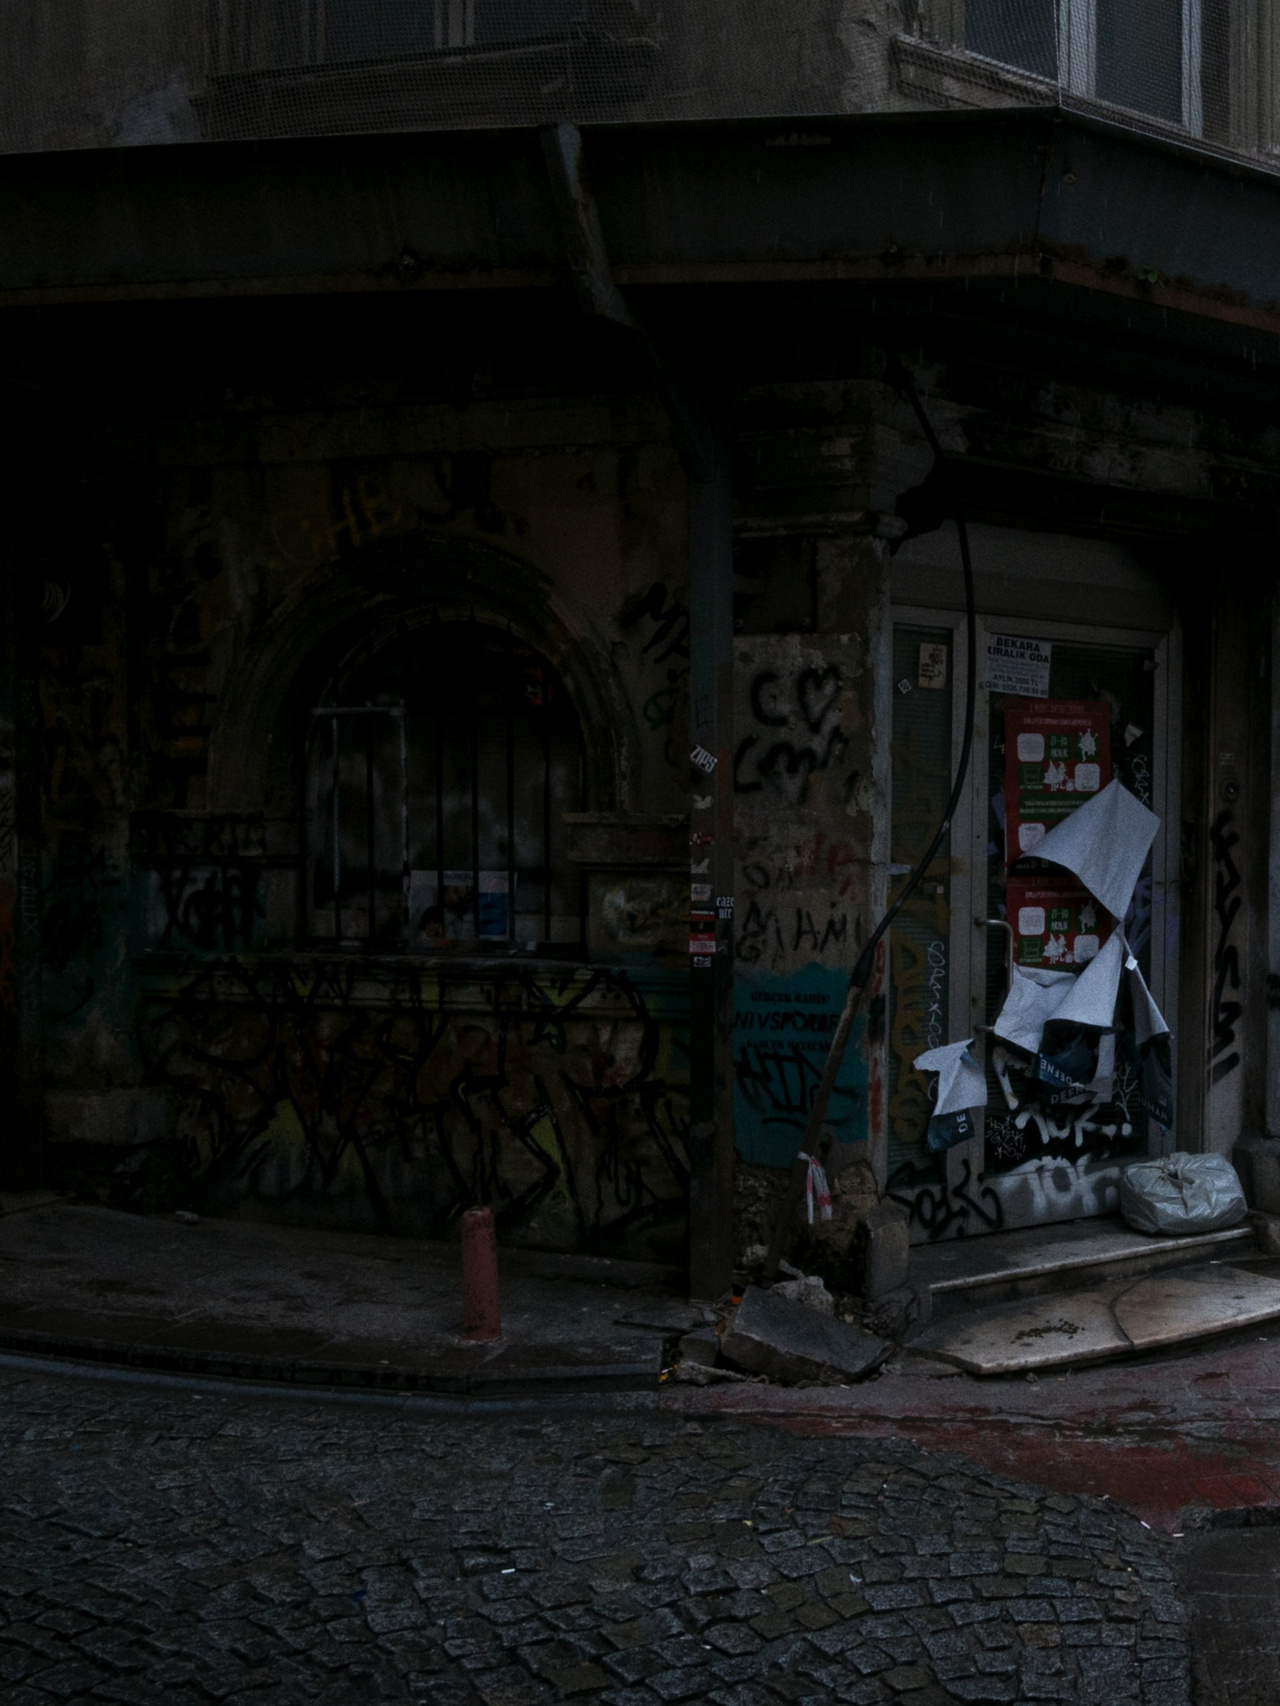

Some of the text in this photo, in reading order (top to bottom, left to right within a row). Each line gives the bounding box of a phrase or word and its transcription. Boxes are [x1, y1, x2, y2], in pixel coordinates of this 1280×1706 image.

[996, 637, 1041, 653] BEKARA
[1029, 653, 1050, 664] ODA
[1040, 1059, 1072, 1085] DEFNE
